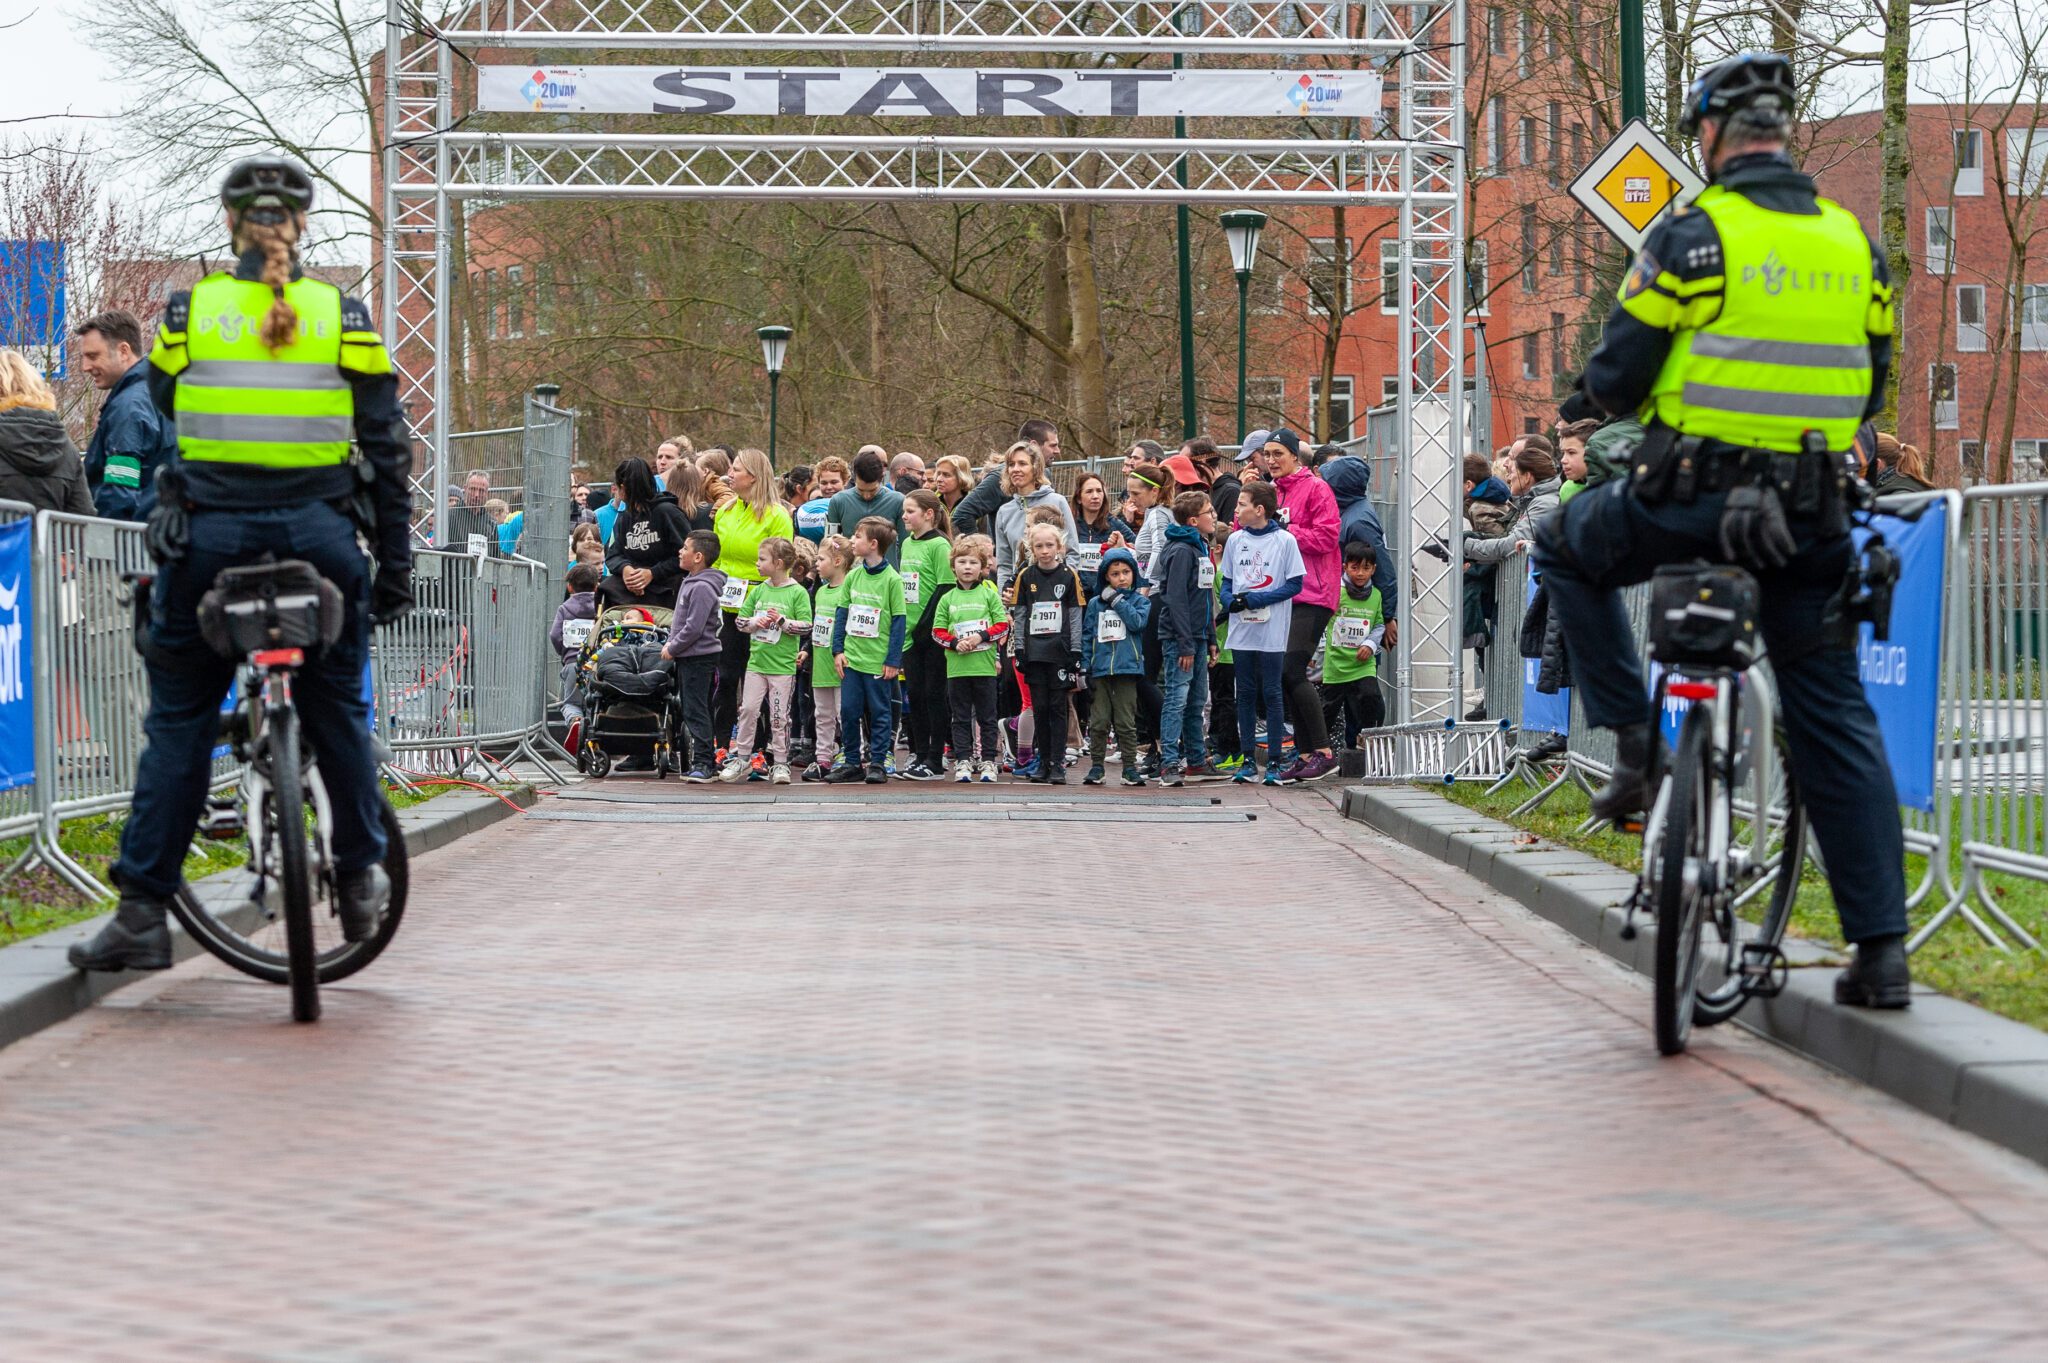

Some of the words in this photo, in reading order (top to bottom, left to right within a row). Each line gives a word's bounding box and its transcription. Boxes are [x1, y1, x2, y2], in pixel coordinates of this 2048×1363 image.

[541, 82, 558, 99] 20
[652, 71, 1174, 118] START
[1307, 86, 1324, 102] 20
[903, 581, 917, 591] 732
[857, 614, 875, 625] 7683
[1039, 611, 1057, 621] 7977
[1348, 627, 1364, 637] 7116
